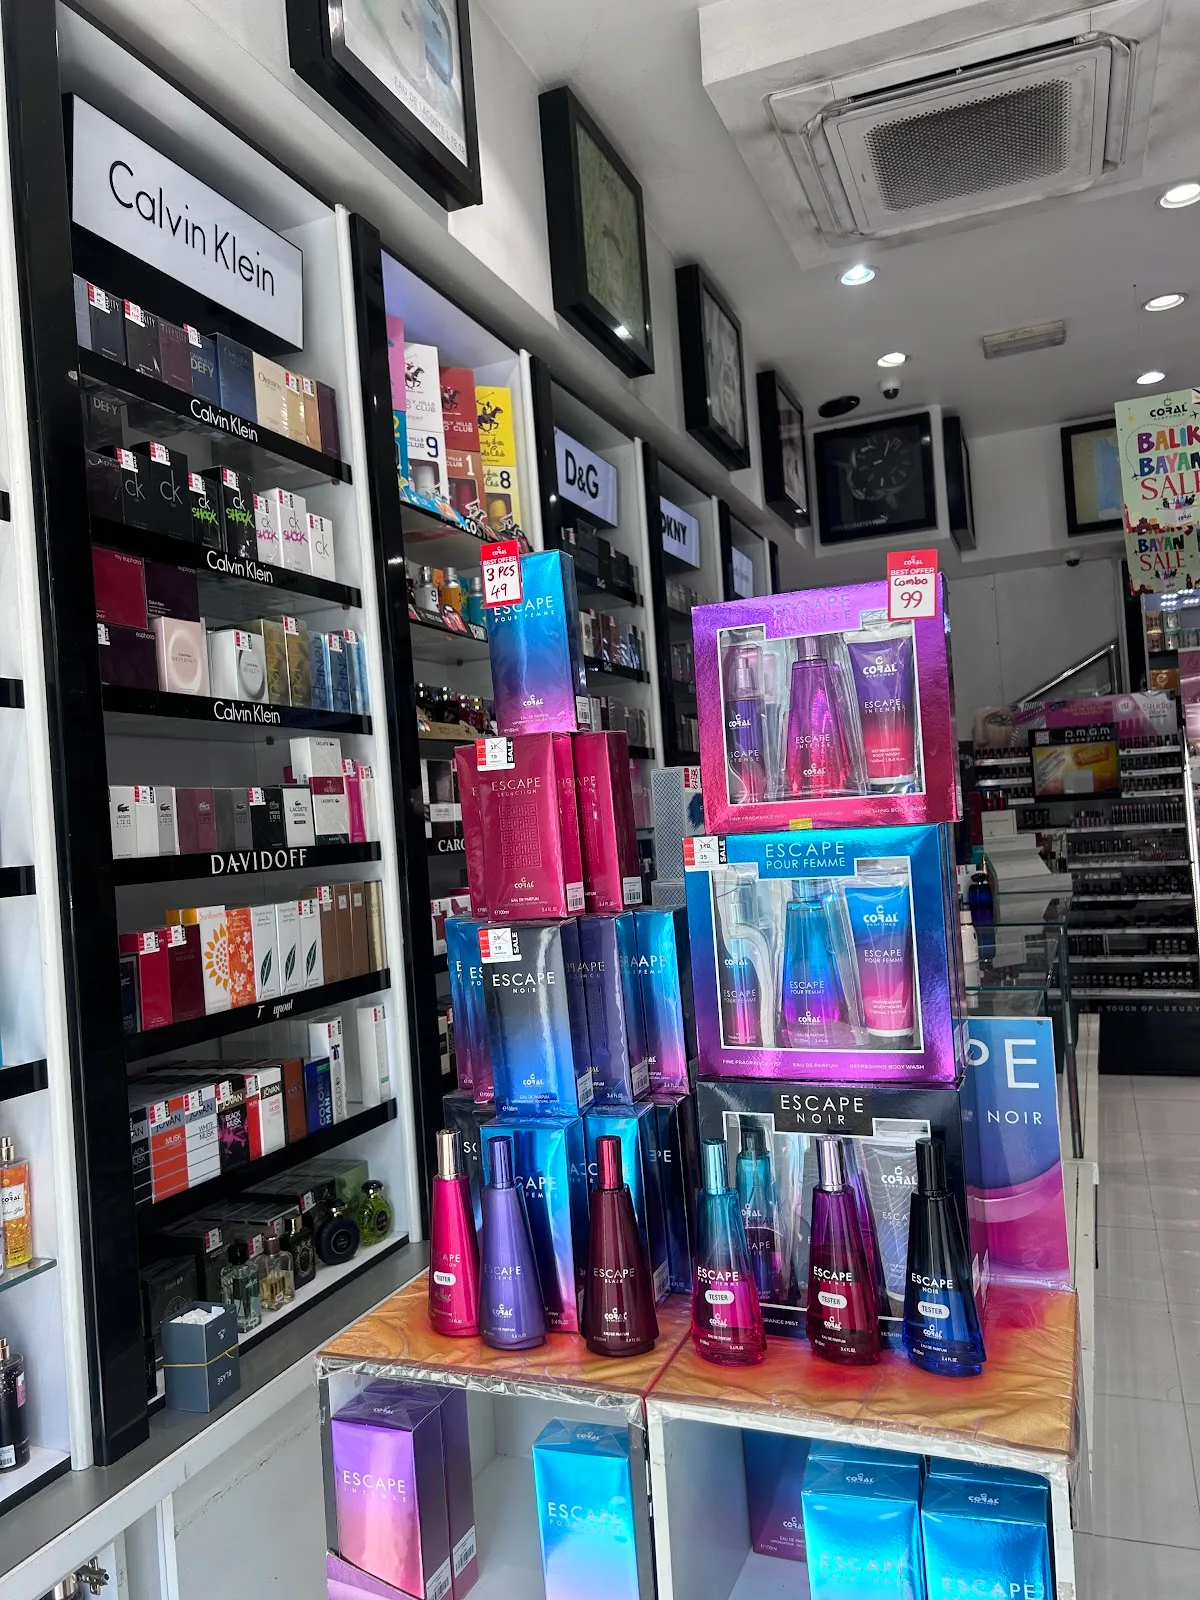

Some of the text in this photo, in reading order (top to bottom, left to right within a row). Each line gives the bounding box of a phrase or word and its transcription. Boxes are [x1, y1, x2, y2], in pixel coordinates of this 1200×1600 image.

[109, 160, 275, 297] Calvin Klein
[191, 358, 215, 378] DEFY
[93, 397, 118, 416] DEFY
[415, 404, 436, 413] CLUB
[1150, 404, 1188, 418] CORAL
[190, 399, 259, 443] Calvin Klein
[1137, 425, 1200, 454] BALIK
[426, 436, 439, 458] 9
[466, 455, 475, 476] 1
[500, 470, 511, 489] 8
[564, 448, 599, 499] D&G
[160, 470, 183, 505] ck
[315, 533, 330, 557] ck
[1138, 534, 1185, 553] BAYAN
[206, 550, 273, 583] Calvin Klein
[483, 558, 497, 566] BEST
[1140, 551, 1187, 572] SALE
[486, 564, 515, 582] 3 PCS
[890, 568, 909, 576] BEST
[894, 576, 928, 587] Combo
[490, 583, 508, 600] 49
[493, 596, 554, 616] ESCAPE
[773, 594, 850, 617] ESCAPE
[901, 590, 923, 609] 99
[494, 610, 555, 623] POUR FEMME
[863, 663, 898, 675] CORAL
[523, 698, 544, 707] CORAL
[864, 699, 901, 709] ESCAPE
[214, 701, 281, 724] Calvin Klein
[729, 719, 751, 728] CORAL
[795, 734, 830, 744] ESCAPE
[803, 767, 826, 776] CORAL
[492, 777, 541, 792] ESCAPE
[497, 789, 537, 798] SEDUCTION
[719, 840, 727, 863] SALE
[766, 841, 845, 858] ESCAPE
[211, 849, 307, 875] DAVIDOFF
[766, 857, 846, 870] POUR FEMME
[514, 881, 534, 889] CORAL
[863, 914, 899, 924] CORAL
[512, 932, 520, 954] SALE
[864, 949, 902, 958] ESCAPE
[883, 956, 903, 964] FEMME
[492, 972, 556, 987] ESCAPE
[789, 981, 825, 990] ESCAPE
[523, 1078, 544, 1086] CORAL
[263, 1085, 280, 1097] JOVAN
[221, 1093, 243, 1109] JOVAN
[780, 1094, 864, 1113] ESCAPE
[225, 1111, 241, 1121] BLACK
[796, 1113, 845, 1125] NOIR
[987, 1110, 1043, 1125] NOIR
[199, 1122, 214, 1131] WHITE
[226, 1120, 241, 1128] MUSK
[165, 1133, 182, 1145] MUSK
[199, 1131, 215, 1141] MUSK
[514, 1176, 557, 1190] CAPE
[881, 1174, 918, 1185] CORAL
[484, 1264, 521, 1275] ESCAPE
[593, 1267, 635, 1279] ESCAPE
[697, 1266, 739, 1282] ESCAPE
[813, 1265, 853, 1282] ESCAPE
[436, 1274, 451, 1282] TESTER
[911, 1272, 954, 1289] ESCAPE
[709, 1293, 729, 1301] TESTER
[922, 1287, 939, 1295] NOIR
[821, 1295, 841, 1305] TESTER
[921, 1304, 943, 1315] TESTER
[784, 1319, 799, 1327] MIST
[343, 1470, 406, 1494] ESCAPE
[845, 1476, 875, 1484] CORAL
[344, 1486, 407, 1503] INTENSE
[968, 1495, 1000, 1506] CORAL
[547, 1501, 621, 1527] ESCAPE
[820, 1552, 909, 1574] ESCAPE
[942, 1576, 1037, 1600] ESCAPE
